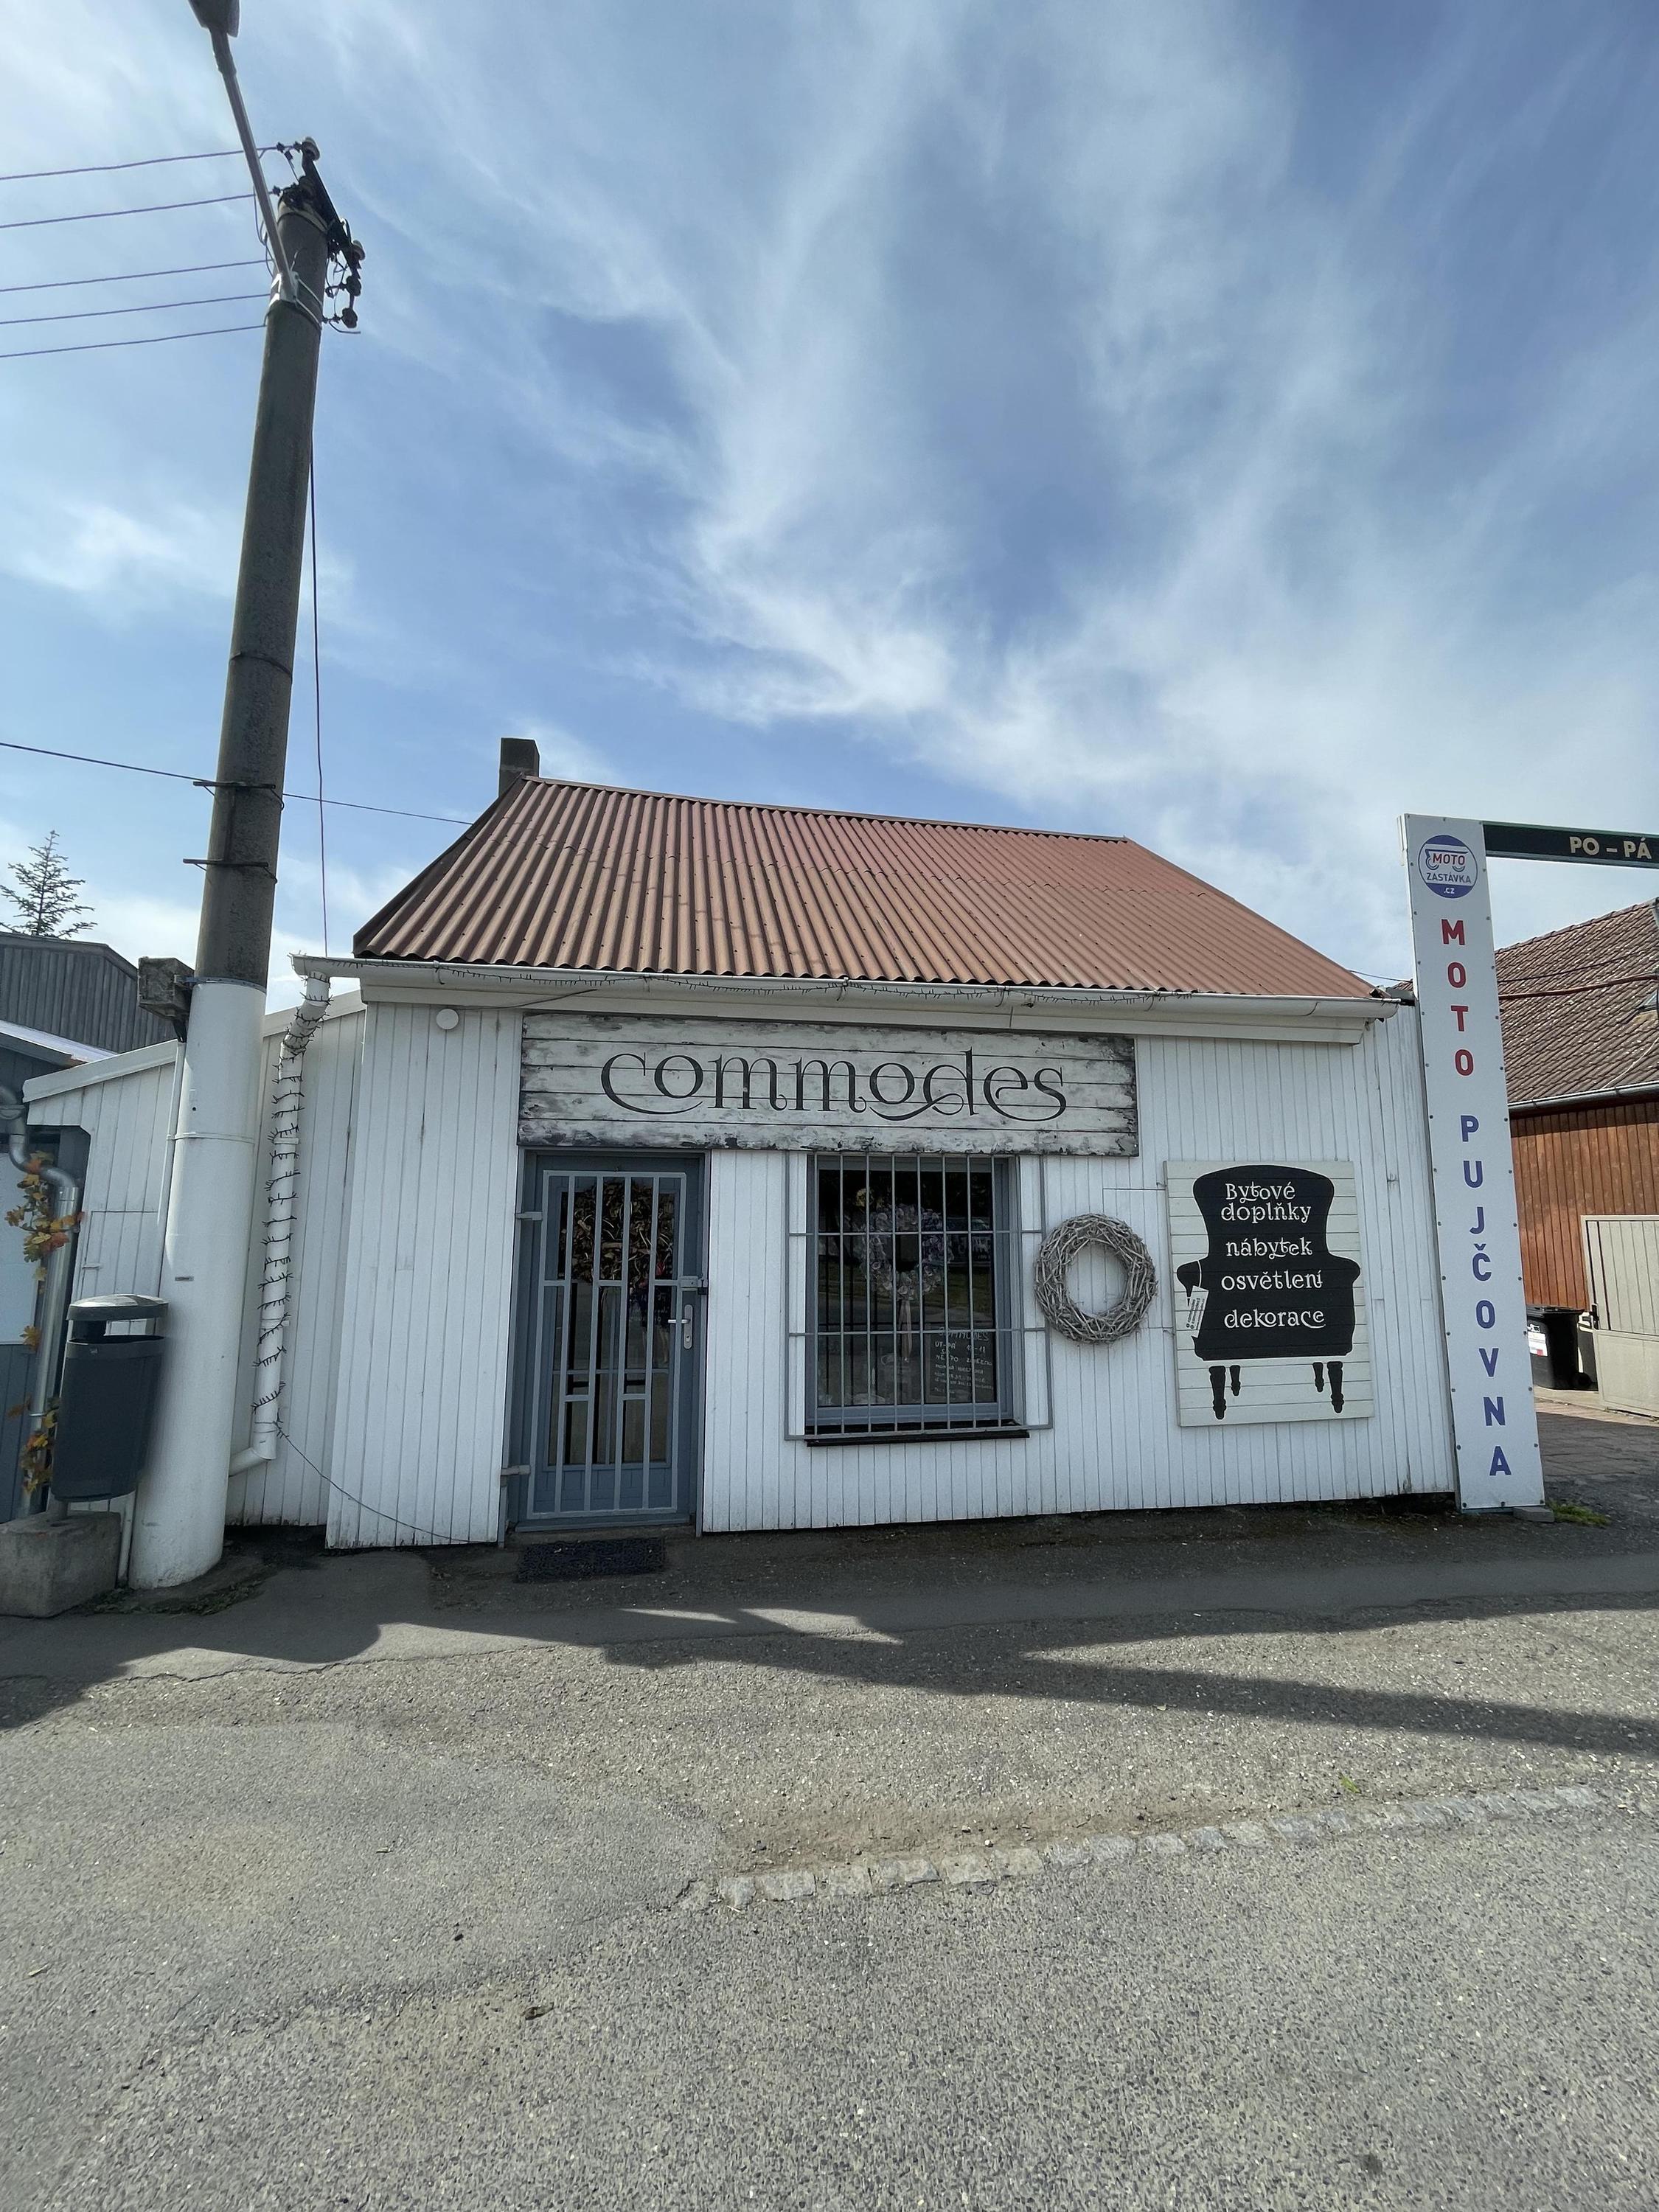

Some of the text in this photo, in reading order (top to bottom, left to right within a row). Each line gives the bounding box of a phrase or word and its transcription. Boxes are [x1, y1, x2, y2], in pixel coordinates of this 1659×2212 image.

[1569, 836, 1600, 855] PO
[1623, 837, 1652, 859] PÁ
[1433, 853, 1465, 865] MOTO
[1426, 872, 1472, 884] ZASTÁVKA
[1225, 1181, 1295, 1203] Bytové
[1441, 919, 1512, 1475] MOTO PUJČOVNA
[1220, 1203, 1312, 1224] doplňky
[1225, 1237, 1313, 1259] nábytek
[1220, 1270, 1324, 1290] osvětlení
[1224, 1308, 1326, 1329] dekorace
